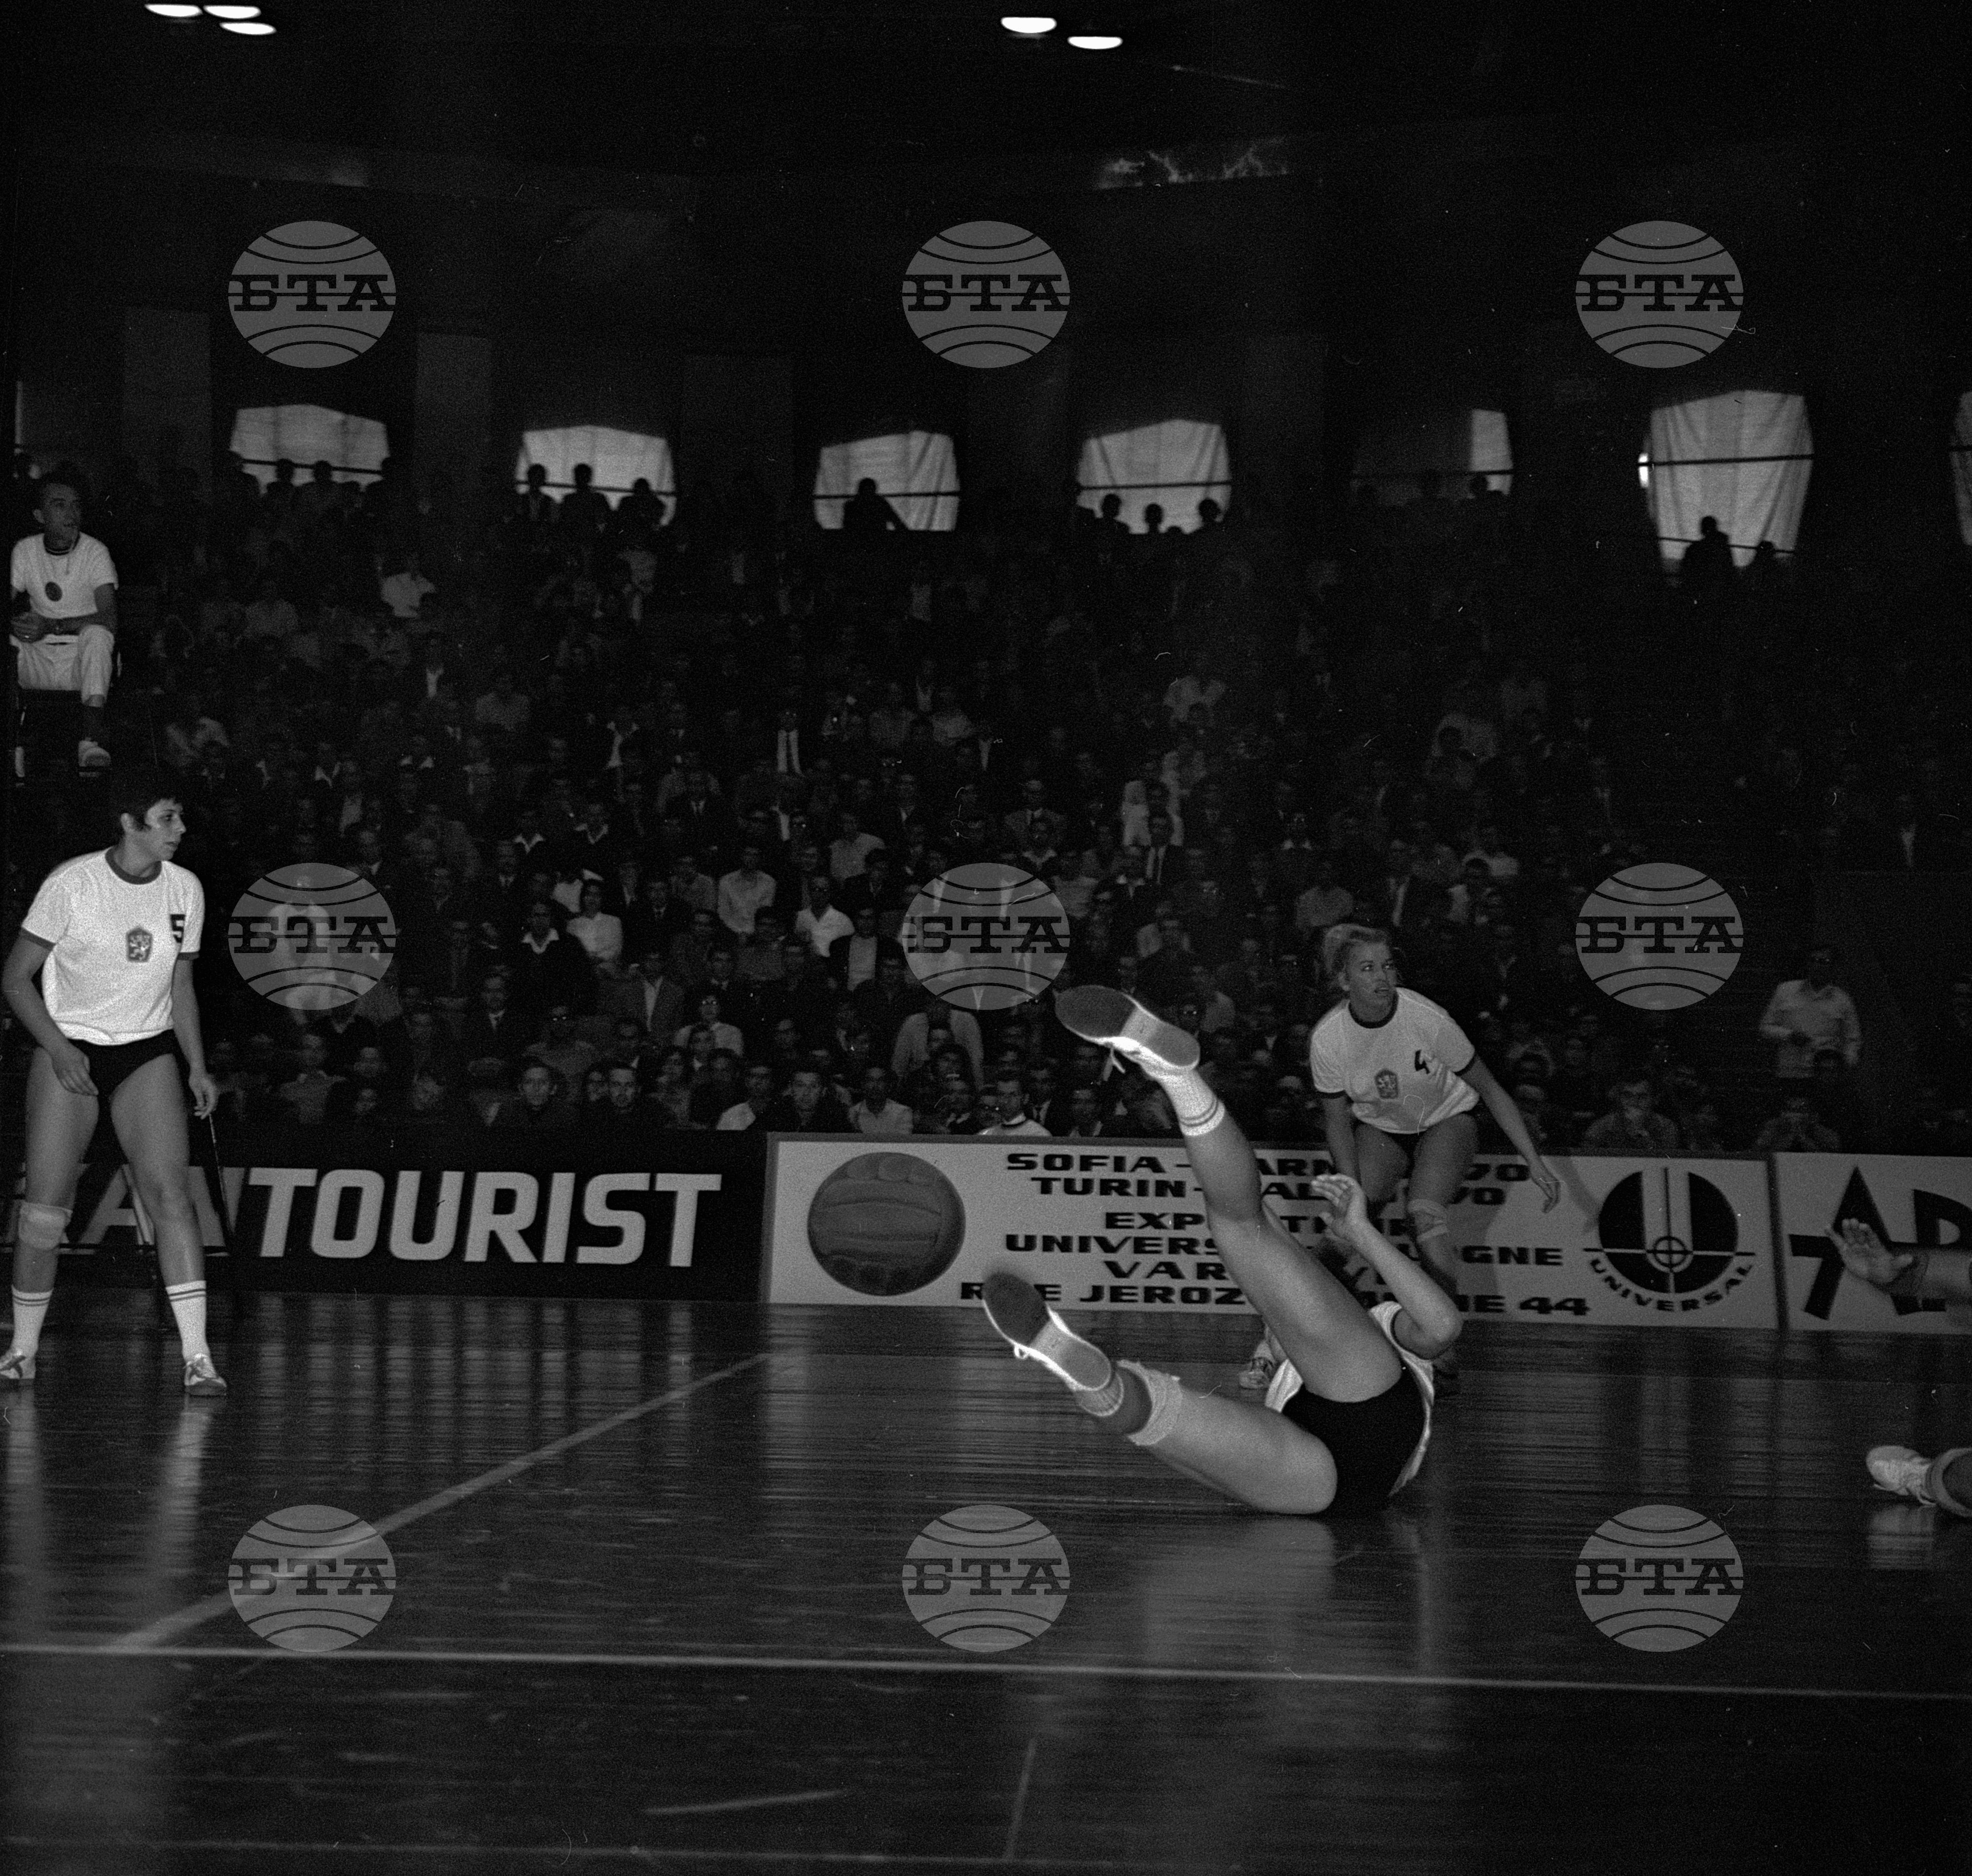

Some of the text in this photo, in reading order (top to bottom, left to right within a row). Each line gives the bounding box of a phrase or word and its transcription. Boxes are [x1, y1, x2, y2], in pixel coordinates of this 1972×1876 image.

[170, 914, 185, 943] 5
[1414, 1050, 1430, 1074] 4
[1461, 1245, 1562, 1265] GNE
[961, 1282, 1061, 1301] RE
[1519, 1297, 1589, 1315] 44
[1590, 1259, 1753, 1311] UNIVERSAL
